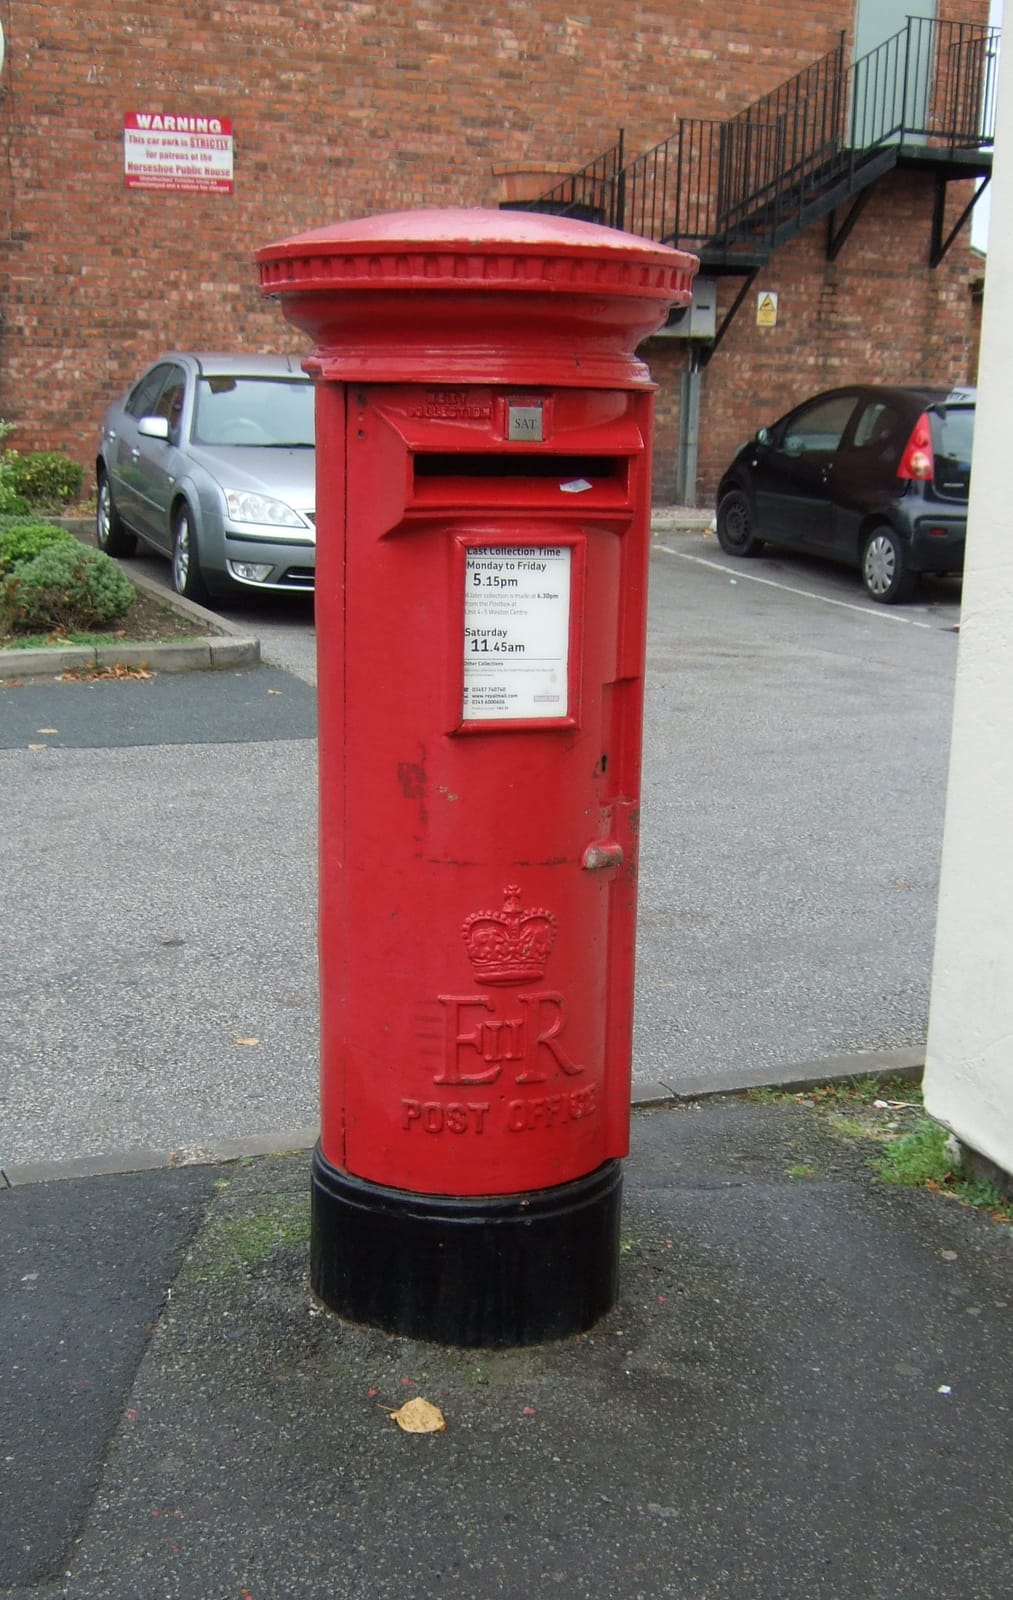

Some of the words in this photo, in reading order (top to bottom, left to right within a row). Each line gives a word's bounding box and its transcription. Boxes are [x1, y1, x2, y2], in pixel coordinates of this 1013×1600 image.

[136, 113, 222, 134] WARNING
[128, 134, 145, 144] This
[147, 137, 159, 145] car
[161, 136, 179, 147] park
[181, 138, 188, 147] is
[190, 136, 228, 150] STRICTLY
[145, 150, 157, 159] for
[159, 150, 188, 161] patrons
[190, 152, 198, 161] of
[200, 152, 212, 162] the
[127, 162, 174, 174] Horseshoe
[175, 164, 202, 175] Public
[204, 166, 231, 177] House
[514, 418, 537, 430] SAT
[467, 547, 487, 556] Last
[489, 547, 535, 556] Collection
[536, 547, 561, 557] Time
[467, 561, 503, 571] Monday
[506, 562, 515, 570] to
[517, 561, 547, 573] Friday
[473, 573, 518, 589] 5.15pm
[465, 628, 508, 638] Saturday
[471, 638, 525, 652] 11.45am
[401, 1098, 490, 1135] POST
